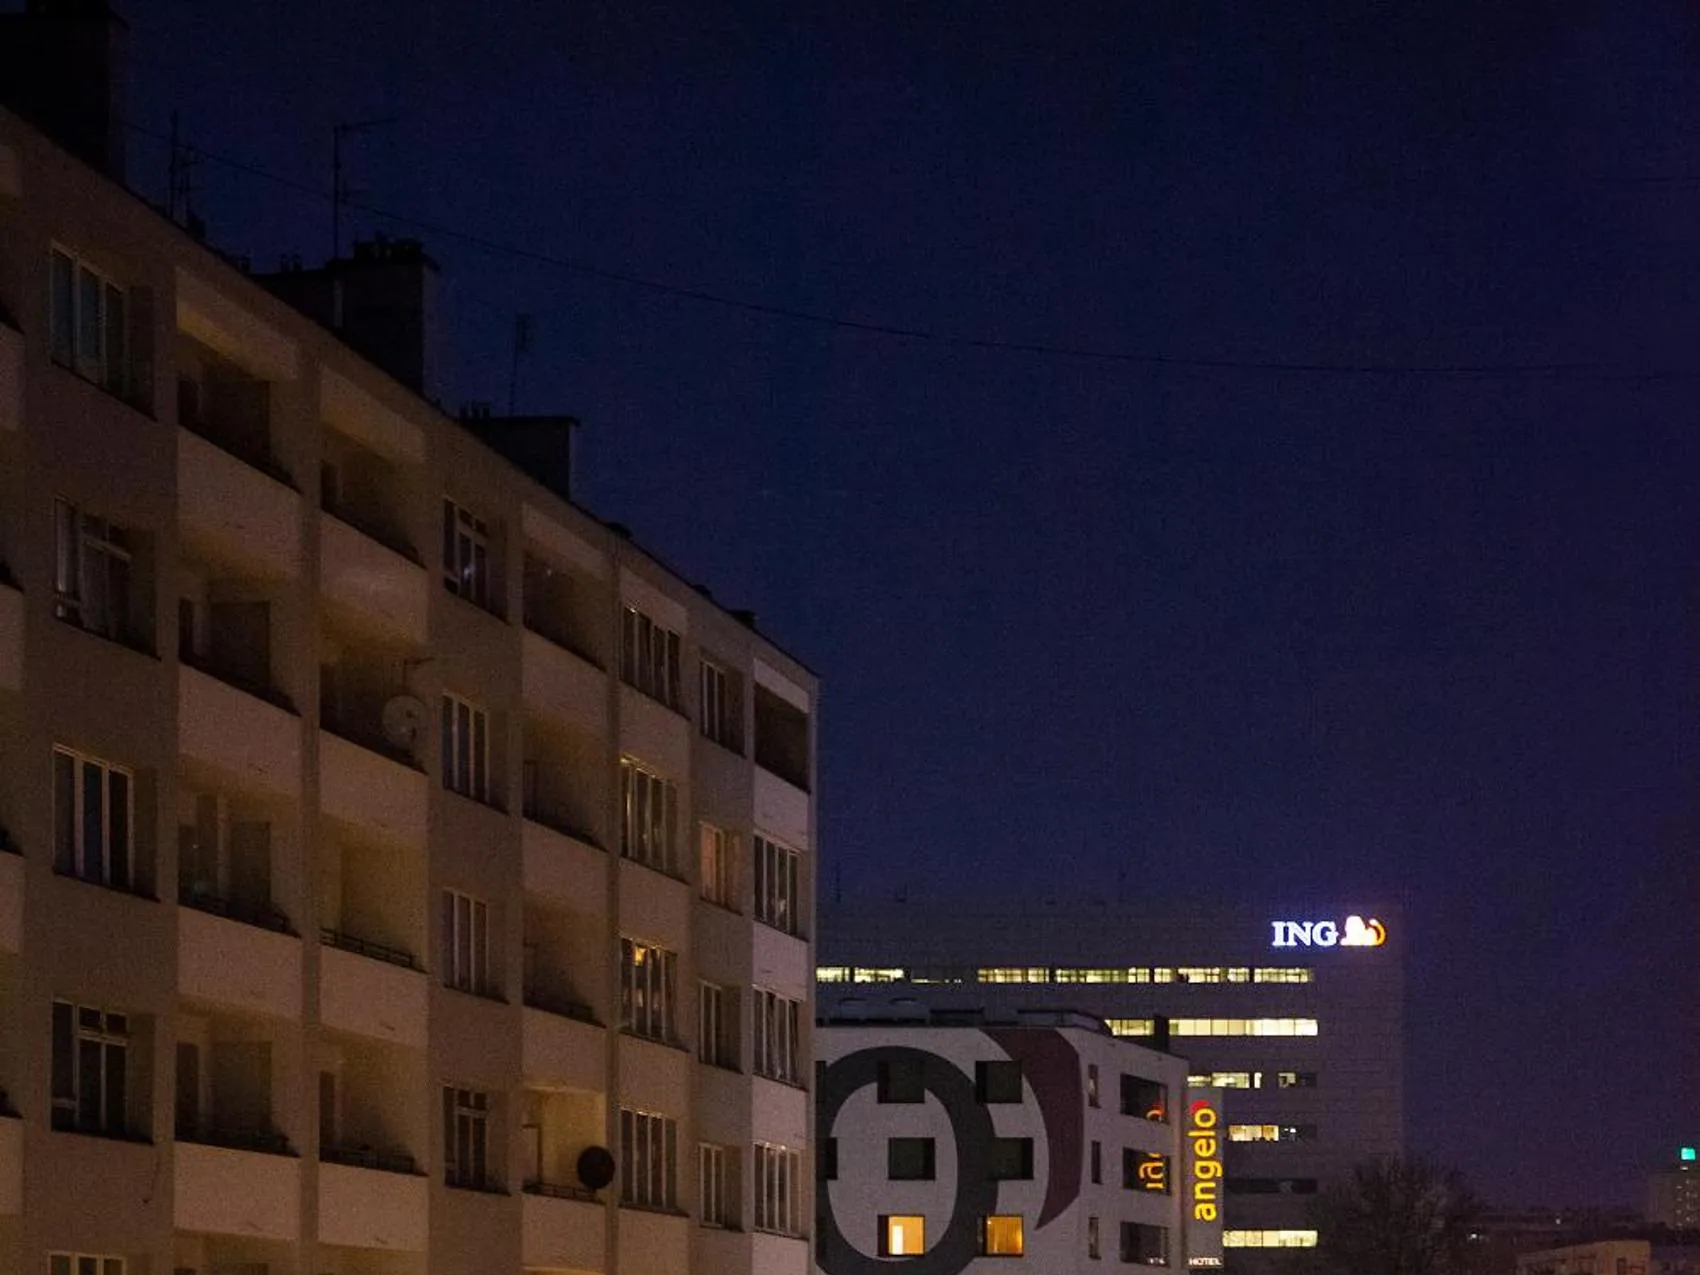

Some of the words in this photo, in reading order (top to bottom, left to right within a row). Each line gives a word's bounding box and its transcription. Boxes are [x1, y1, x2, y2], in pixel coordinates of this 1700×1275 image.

[1271, 921, 1339, 946] ING
[1188, 1107, 1223, 1222] angelo
[1188, 1256, 1222, 1266] HOTEL
